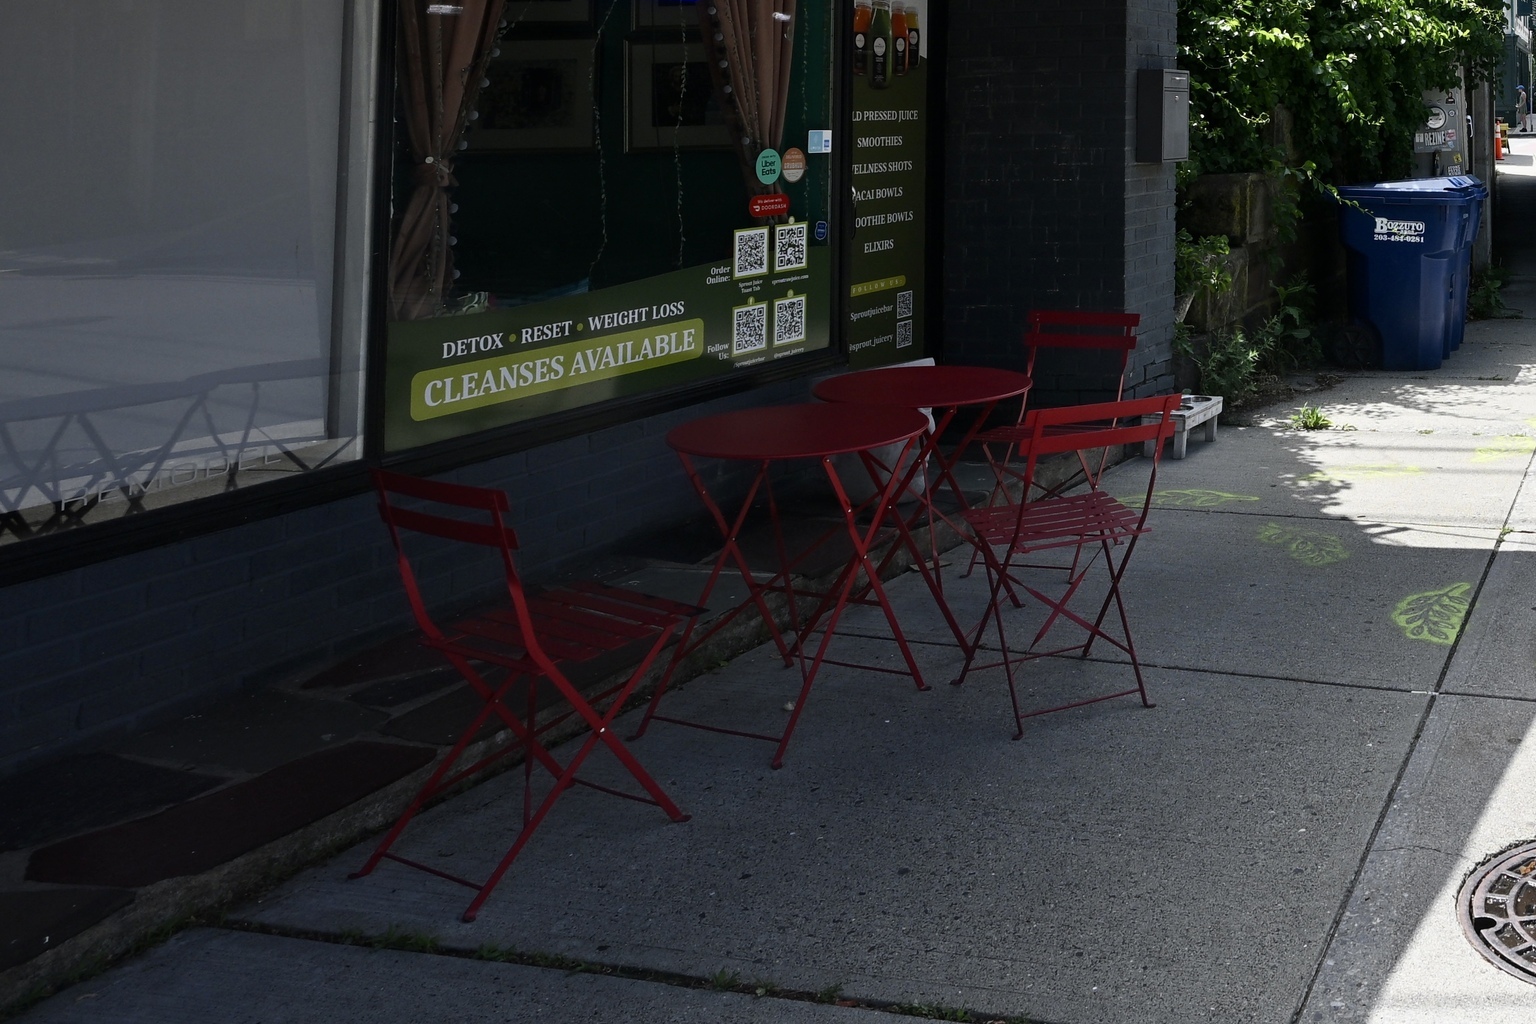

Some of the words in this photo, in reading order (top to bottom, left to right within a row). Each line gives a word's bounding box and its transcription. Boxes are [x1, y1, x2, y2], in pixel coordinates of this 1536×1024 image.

[863, 110, 898, 121] PRESSED
[898, 110, 918, 123] JUICE
[857, 135, 903, 148] SMOOTHIES
[761, 160, 776, 168] Uber
[888, 160, 913, 172] SHOTS
[761, 168, 777, 176] Eats
[855, 188, 875, 201] ACAI
[876, 186, 903, 200] BOWLS
[855, 214, 886, 228] OOTHIE
[887, 211, 914, 224] BOWLS
[864, 239, 894, 254] ELIXIRS
[710, 266, 731, 276] Order
[706, 275, 731, 285] Online:
[852, 282, 886, 294] FOLLOW
[442, 332, 504, 359] DETOX
[520, 320, 573, 345] RESET
[587, 304, 648, 332] WEIGHT
[652, 300, 685, 320] LOSS
[707, 342, 730, 354] Follow
[718, 352, 730, 361] Us:
[423, 355, 564, 408] CLEANSES
[569, 329, 695, 377] AVAILABLE
[61, 447, 281, 511] REMODEL
